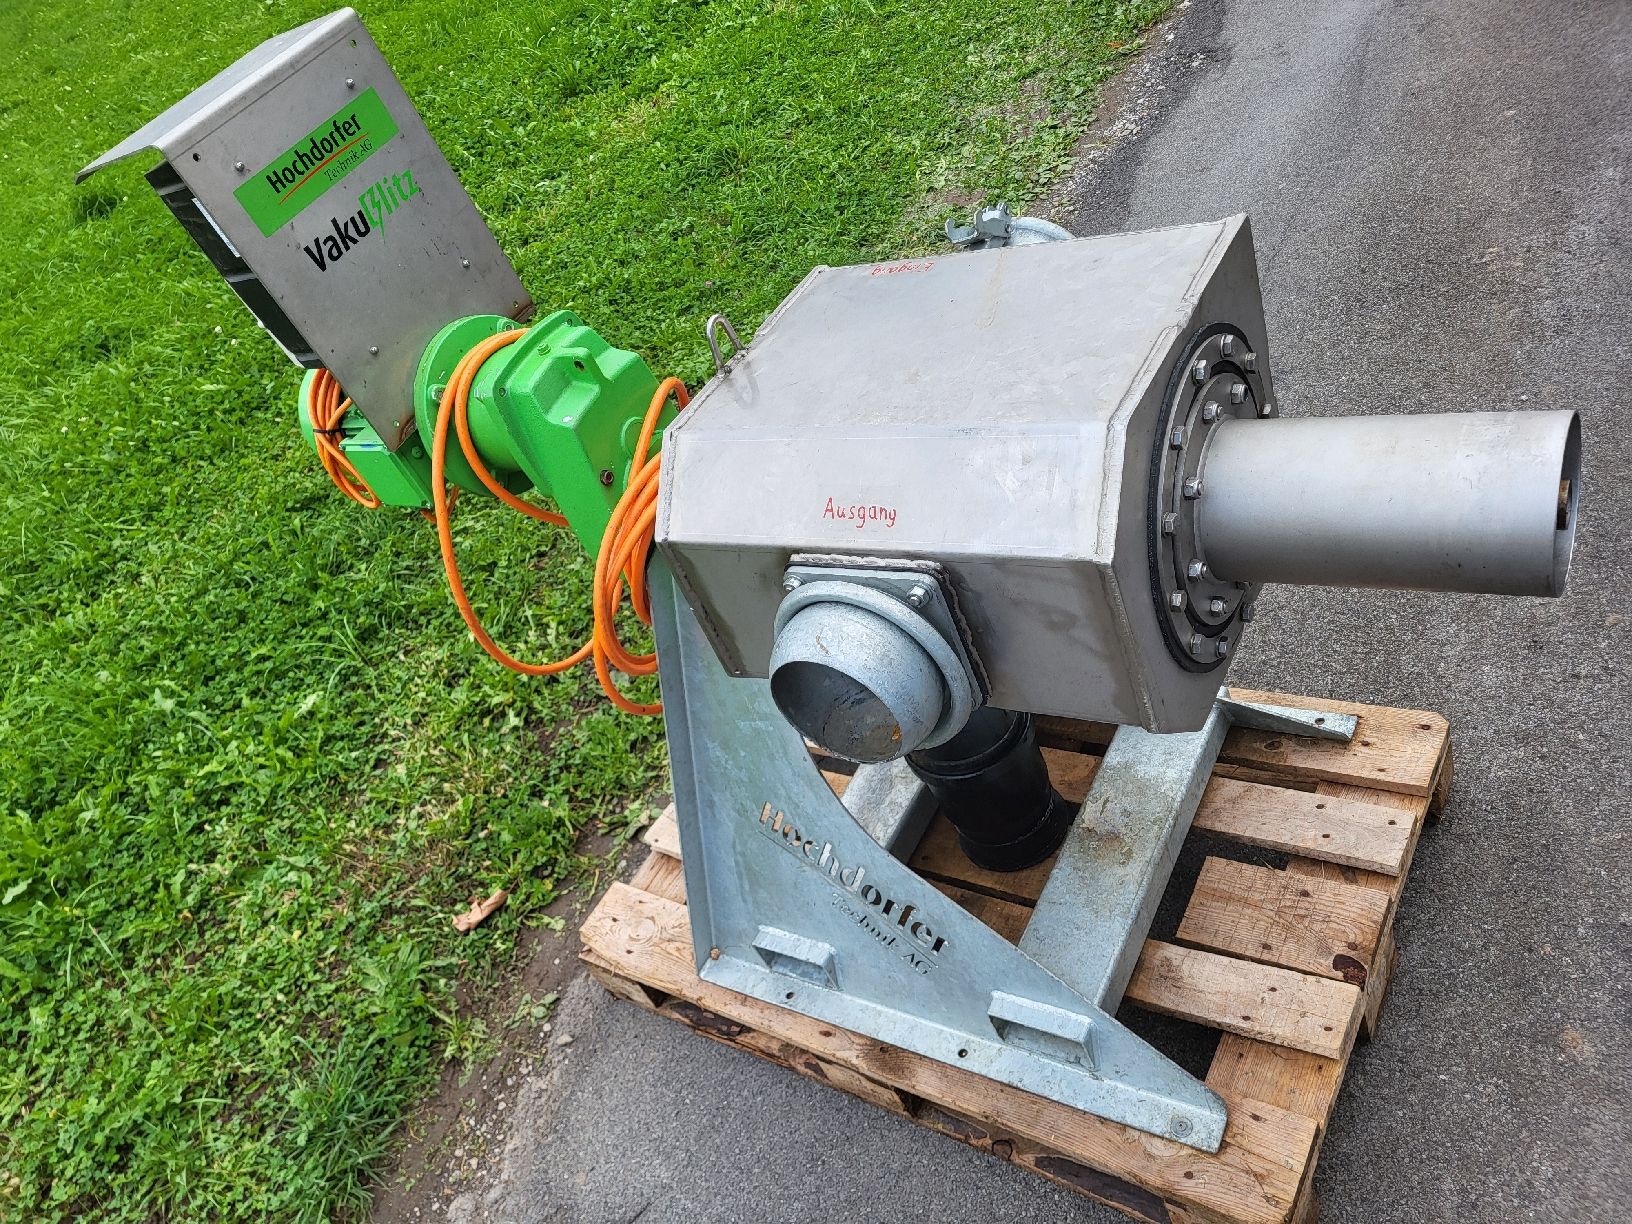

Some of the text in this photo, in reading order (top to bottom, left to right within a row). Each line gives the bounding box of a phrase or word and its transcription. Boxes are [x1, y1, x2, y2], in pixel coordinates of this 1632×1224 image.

[265, 113, 362, 194] Hochdorfer
[324, 138, 373, 182] Technik AG
[759, 801, 949, 956] Hochdorfer
[831, 893, 934, 976] Technik AG
